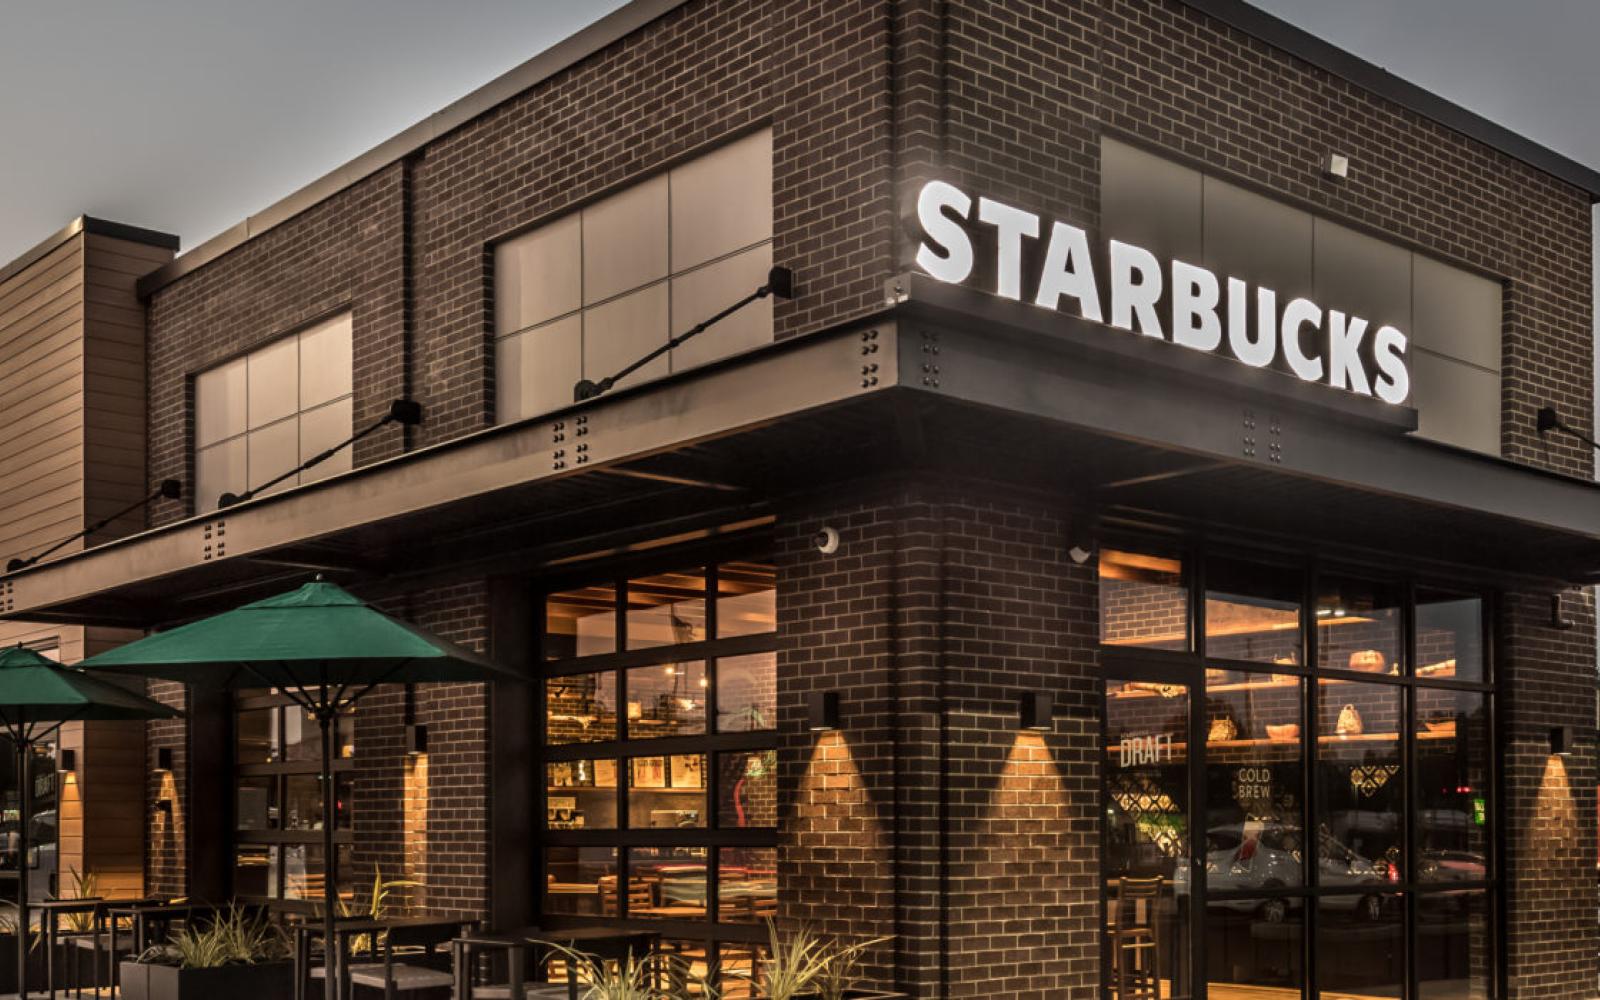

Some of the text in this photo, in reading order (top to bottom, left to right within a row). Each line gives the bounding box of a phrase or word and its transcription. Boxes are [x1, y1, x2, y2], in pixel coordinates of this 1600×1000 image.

[915, 179, 1409, 404] STARBUCKS
[1120, 732, 1174, 768] DRAFT
[1238, 768, 1270, 783] COLD
[1238, 785, 1270, 799] BREW
